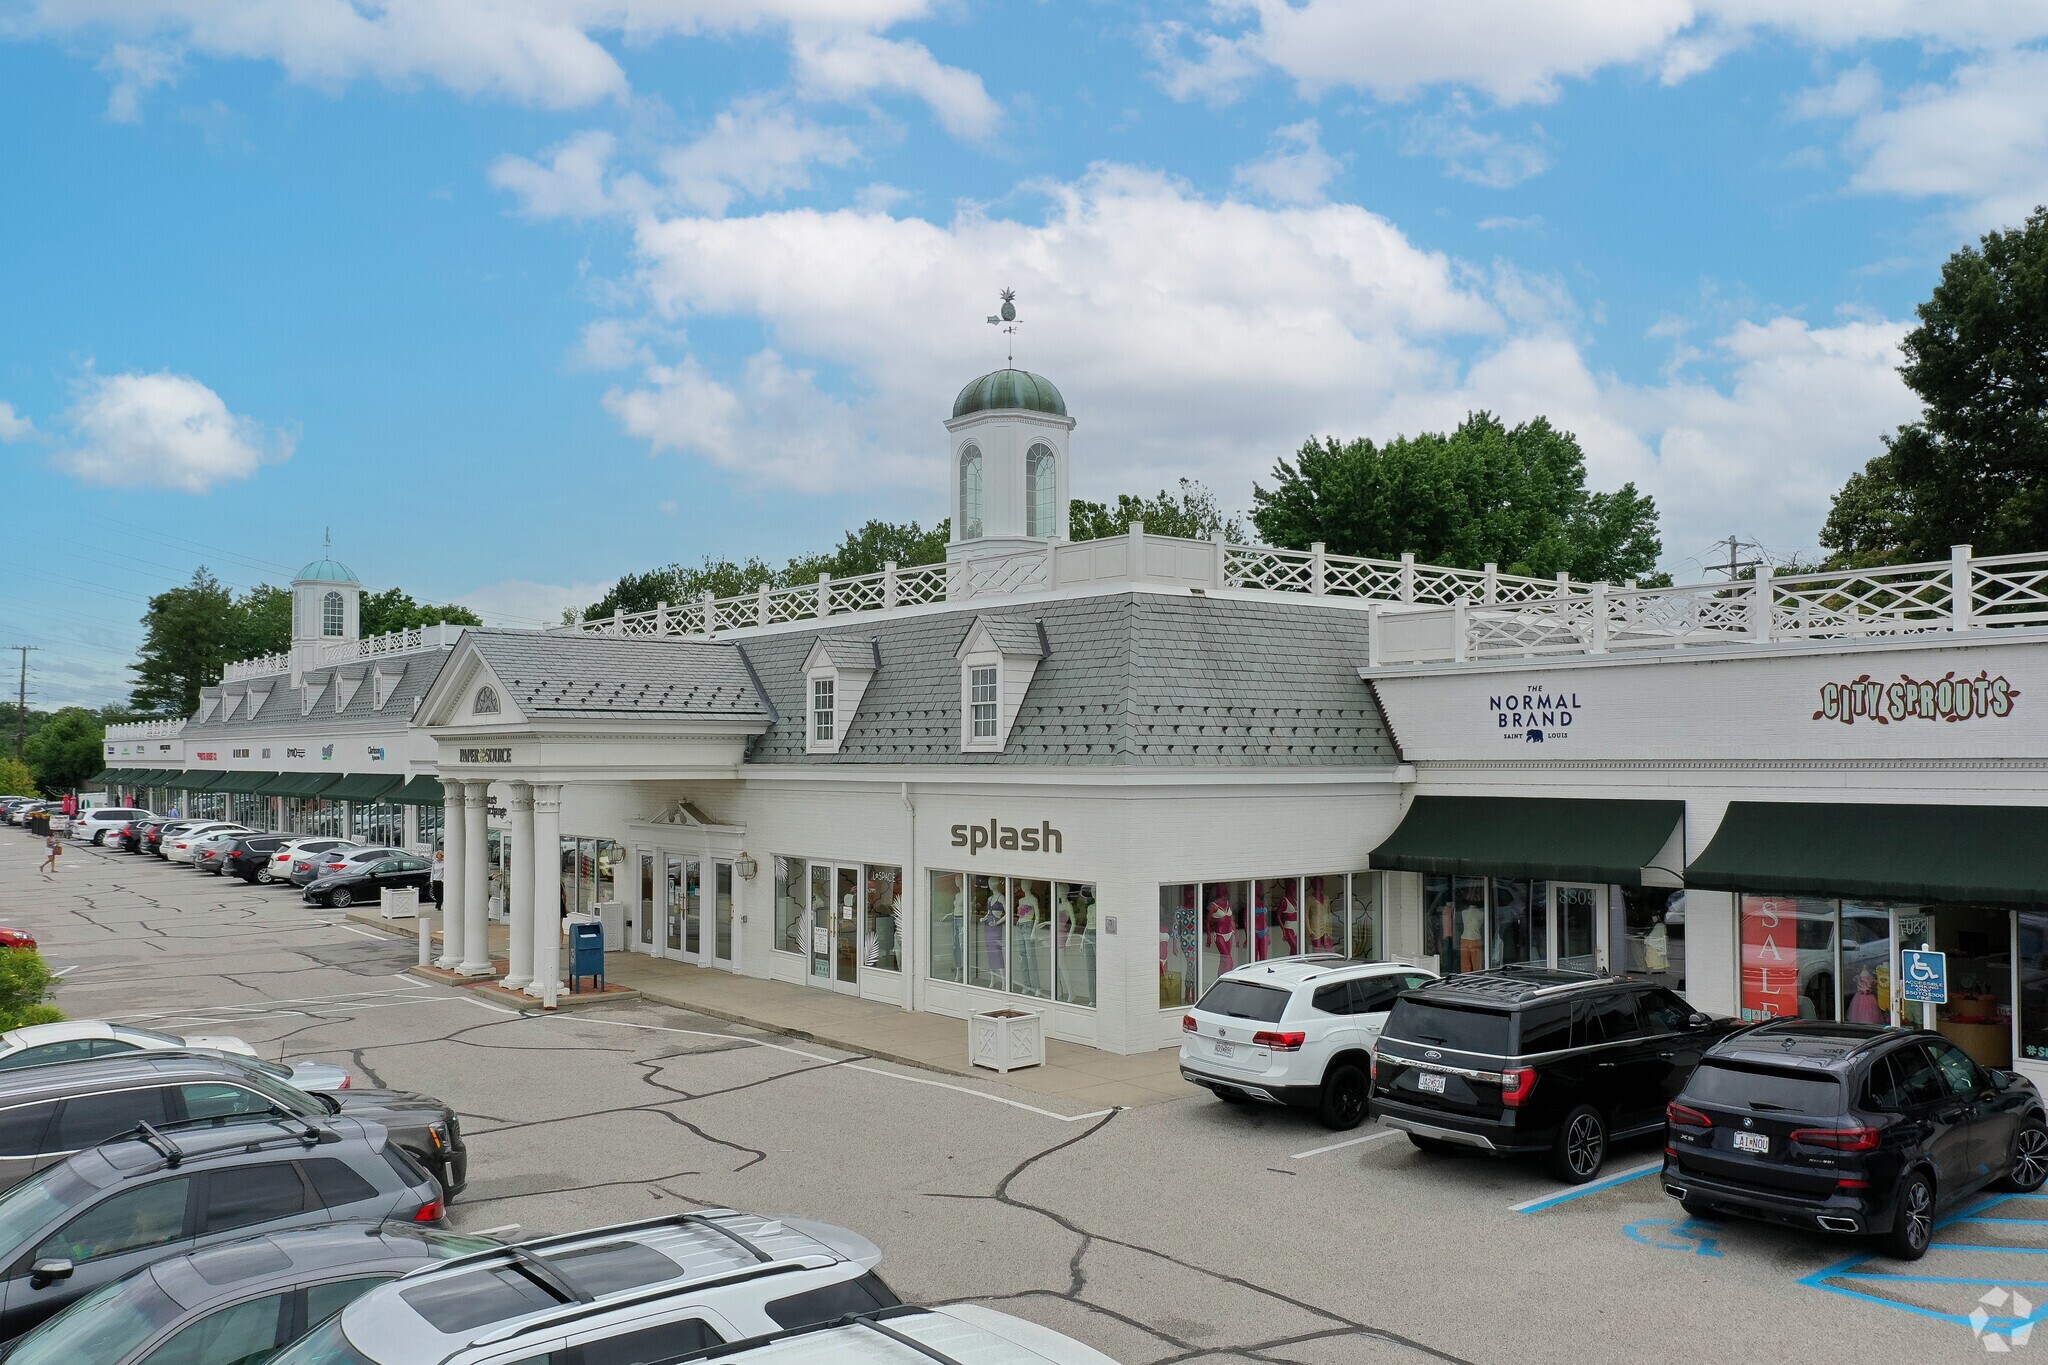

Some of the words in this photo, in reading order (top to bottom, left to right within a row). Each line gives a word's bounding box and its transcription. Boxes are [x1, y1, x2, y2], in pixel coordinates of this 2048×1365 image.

[1490, 693, 1581, 711] NORMAL
[1821, 681, 1884, 723] CITY
[1887, 677, 2013, 721] SPROUTS
[1498, 711, 1573, 728] BRAND
[459, 748, 480, 763] PAPER
[485, 747, 512, 763] SOURCE
[951, 818, 1062, 856] splash
[1559, 888, 1596, 906] 8809
[1905, 980, 1944, 988] ACCESSIBLE
